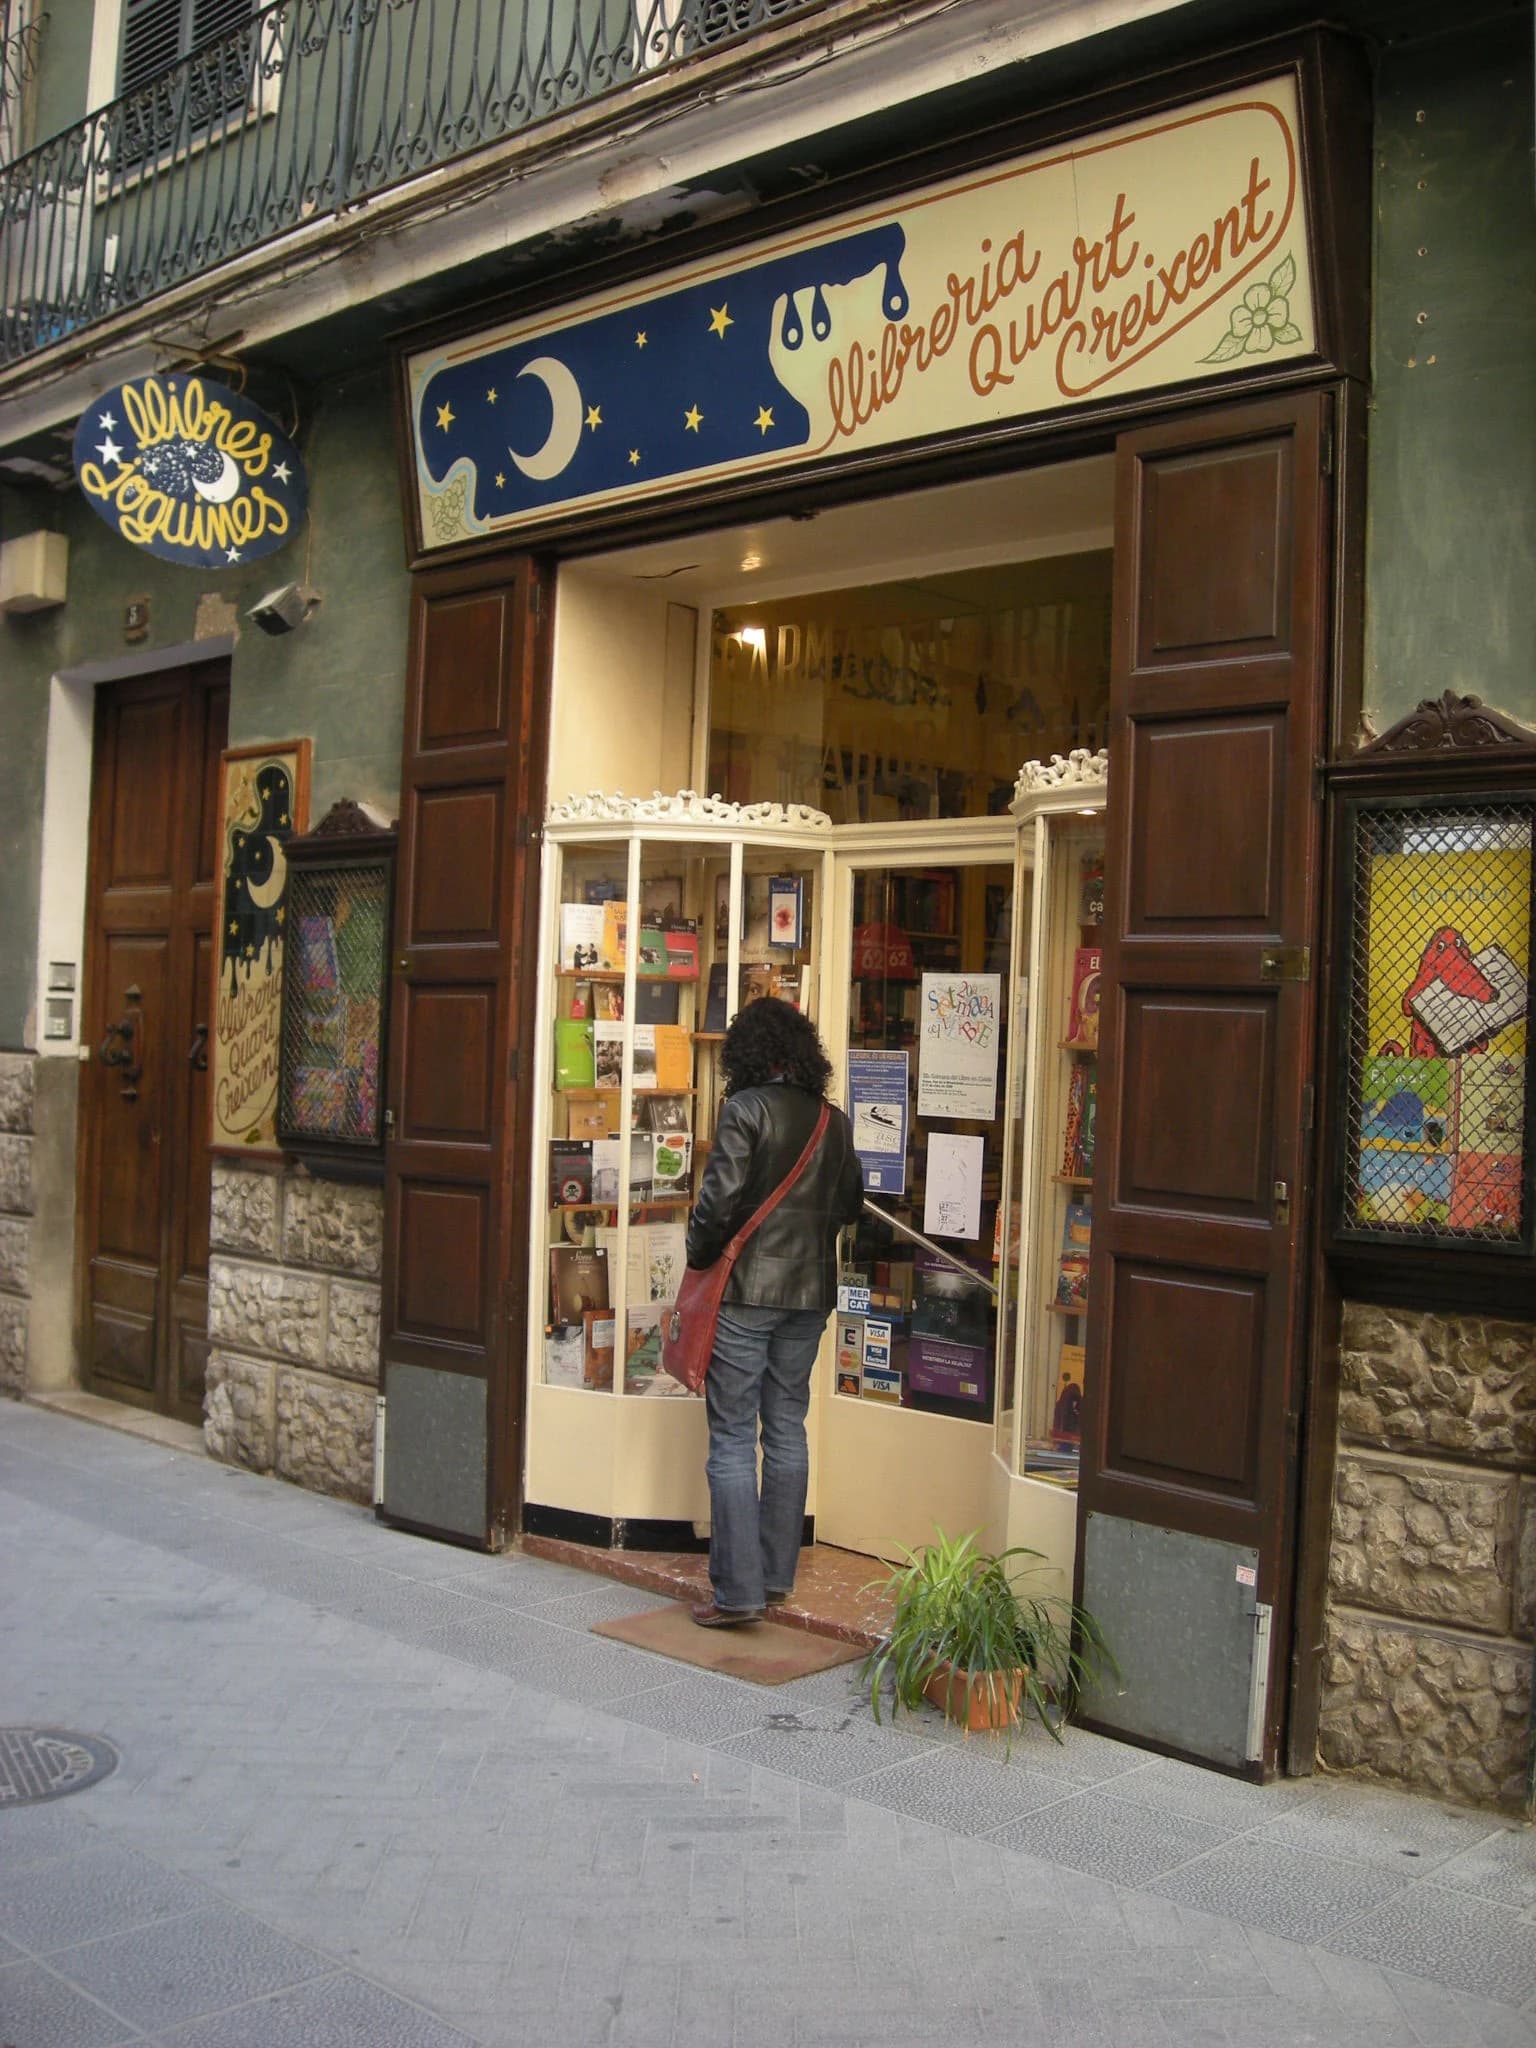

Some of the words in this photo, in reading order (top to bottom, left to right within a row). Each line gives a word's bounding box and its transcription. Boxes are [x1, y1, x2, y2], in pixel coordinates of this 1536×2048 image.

[968, 193, 1140, 396] Quart
[1055, 157, 1274, 398] Creixent
[828, 229, 1042, 436] llibreria
[121, 378, 273, 477] llibres
[849, 1300, 868, 1310] CAT
[850, 1289, 869, 1299] MER
[869, 1329, 886, 1338] VISA
[872, 1380, 890, 1391] VISA
